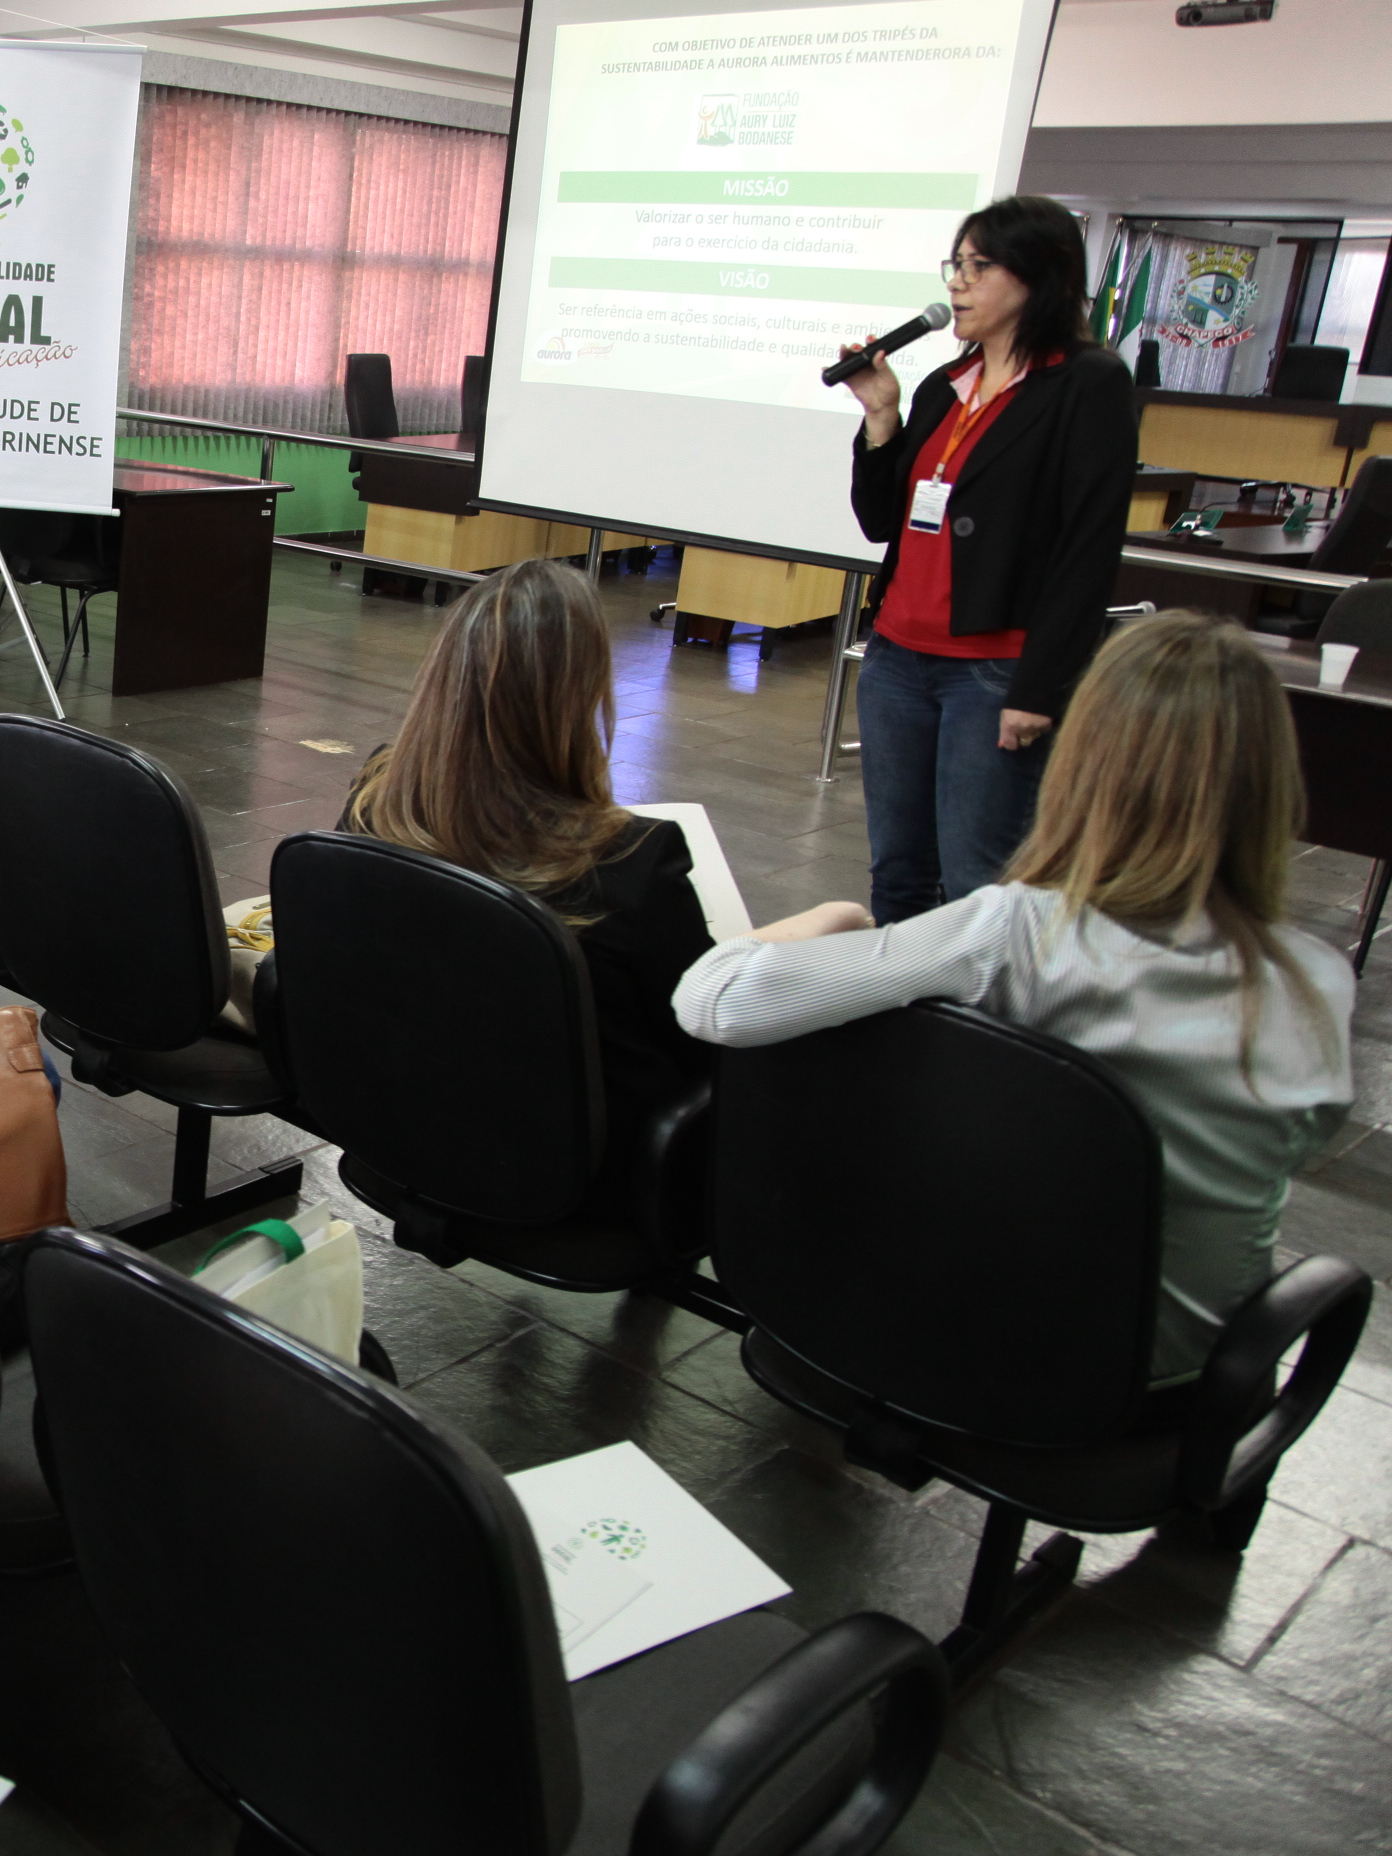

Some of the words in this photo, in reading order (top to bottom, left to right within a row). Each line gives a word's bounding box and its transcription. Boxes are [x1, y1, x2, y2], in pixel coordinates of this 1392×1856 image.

[652, 41, 678, 53] COM
[681, 38, 736, 51] OBJETIVO
[739, 36, 756, 50] DE
[757, 33, 812, 48] ATENDER
[816, 32, 839, 46] UM
[842, 30, 868, 44] DOS
[872, 26, 916, 42] TRIPÉS
[918, 26, 939, 40] DA
[601, 58, 704, 74] SUSTENTABILIDADE
[706, 58, 715, 70] A
[717, 56, 767, 70] AURORA
[770, 52, 842, 68] ALIMENTOS
[845, 48, 854, 64] É
[856, 46, 971, 64] MANTENDERORA
[742, 88, 800, 110] FUNDAÇÃO
[740, 114, 768, 128] AURY
[772, 114, 797, 128] LUIZ
[738, 130, 794, 146] BODANESE
[722, 176, 789, 198] MISSÃO
[635, 210, 691, 224] Valorizar
[695, 214, 704, 224] o
[707, 214, 729, 225] ser
[733, 211, 790, 226] humano
[795, 216, 804, 227] e
[808, 214, 884, 230] contribuir
[652, 236, 682, 250] para
[685, 236, 694, 248] o
[698, 234, 758, 250] exercício
[761, 236, 779, 251] da
[783, 237, 859, 254] cidadania.
[718, 268, 770, 290] VISÃO
[558, 302, 578, 316] Ser
[580, 303, 643, 320] referência
[646, 310, 667, 321] em
[670, 308, 708, 326] ações
[712, 312, 760, 330] sociais,
[765, 315, 827, 333] culturais
[831, 322, 840, 334] e
[560, 326, 640, 342] promovendo
[643, 332, 651, 343] a
[654, 331, 764, 352] sustentabilidade
[768, 342, 777, 352] e
[780, 341, 843, 359] qualida
[536, 349, 572, 360] aurora
[49, 401, 81, 424] DE
